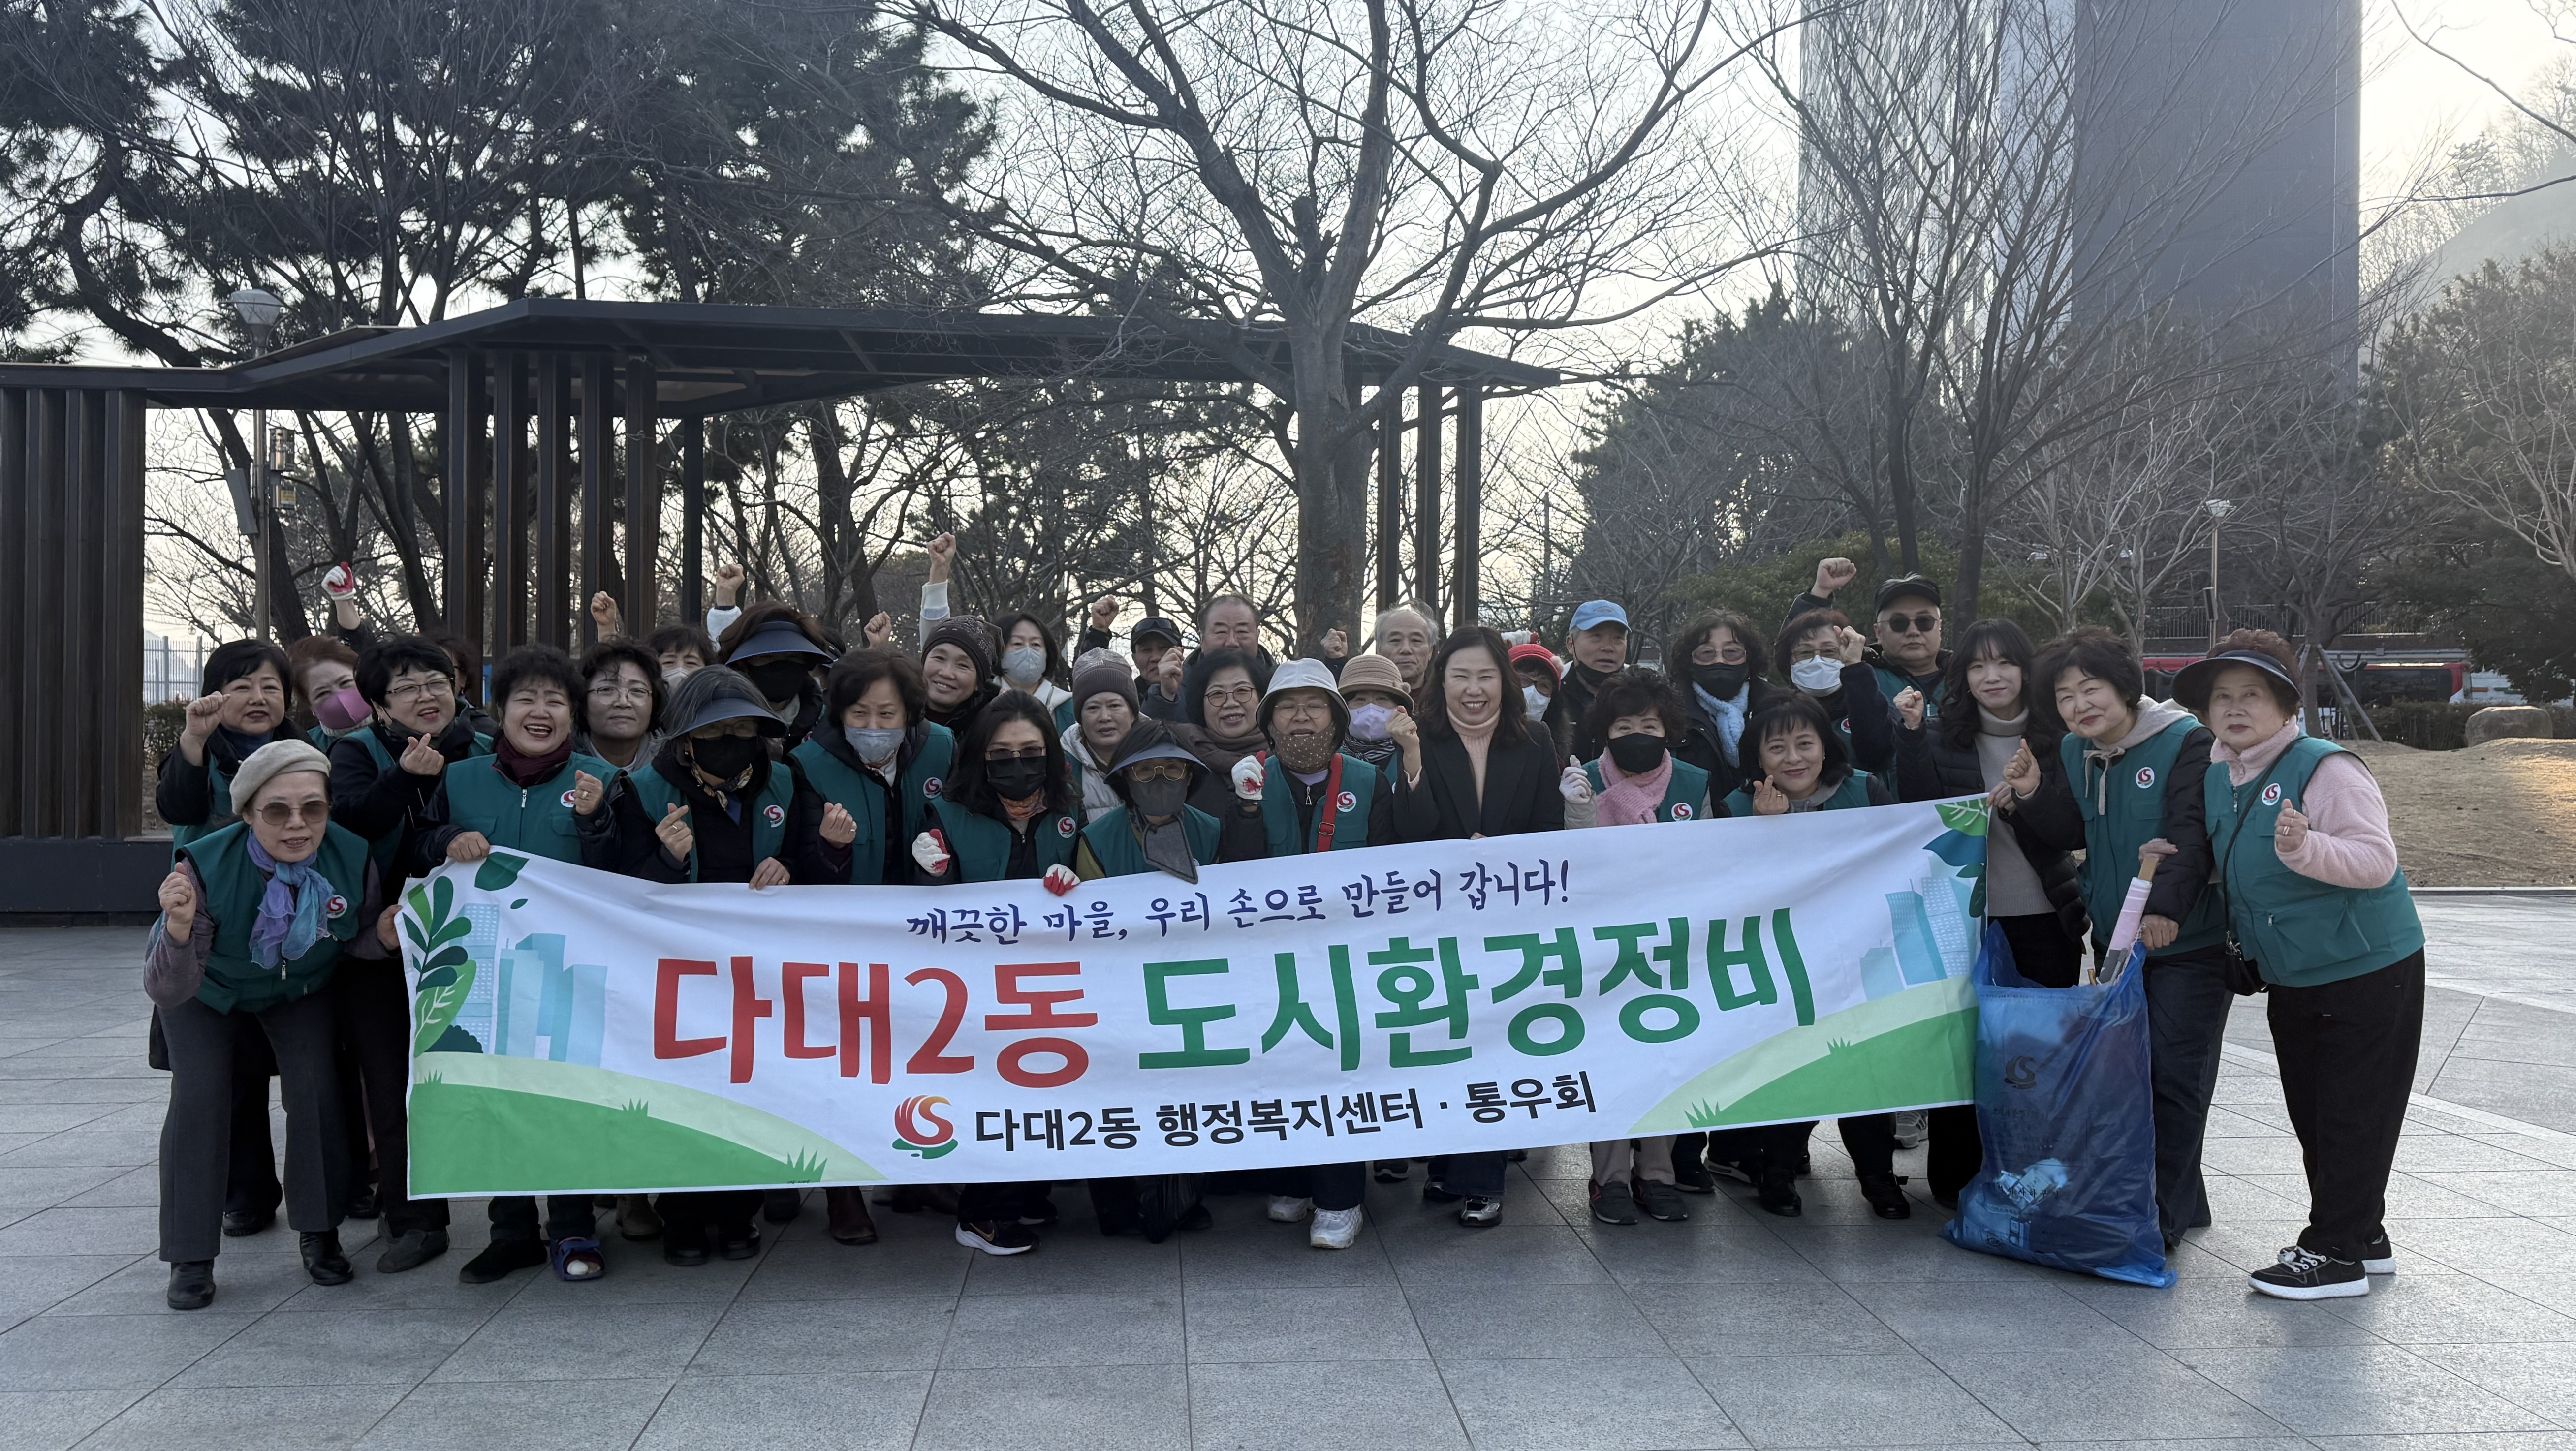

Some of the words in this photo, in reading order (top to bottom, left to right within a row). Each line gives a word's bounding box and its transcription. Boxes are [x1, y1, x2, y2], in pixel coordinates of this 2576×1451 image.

[906, 903, 1028, 945] 깨끗한
[1042, 901, 1128, 942] 마을,
[1145, 892, 1210, 937] 우리
[1227, 884, 1327, 929] 손으로
[1341, 869, 1441, 919] 만들어
[1459, 859, 1569, 911] 갑니다!
[654, 957, 1098, 1088] 다대2동
[1138, 907, 1815, 1070] 도시환경정비
[975, 1107, 1141, 1151] 다대2동
[1156, 1088, 1423, 1147] 행정복지센터
[1465, 1071, 1596, 1124] 통우회
